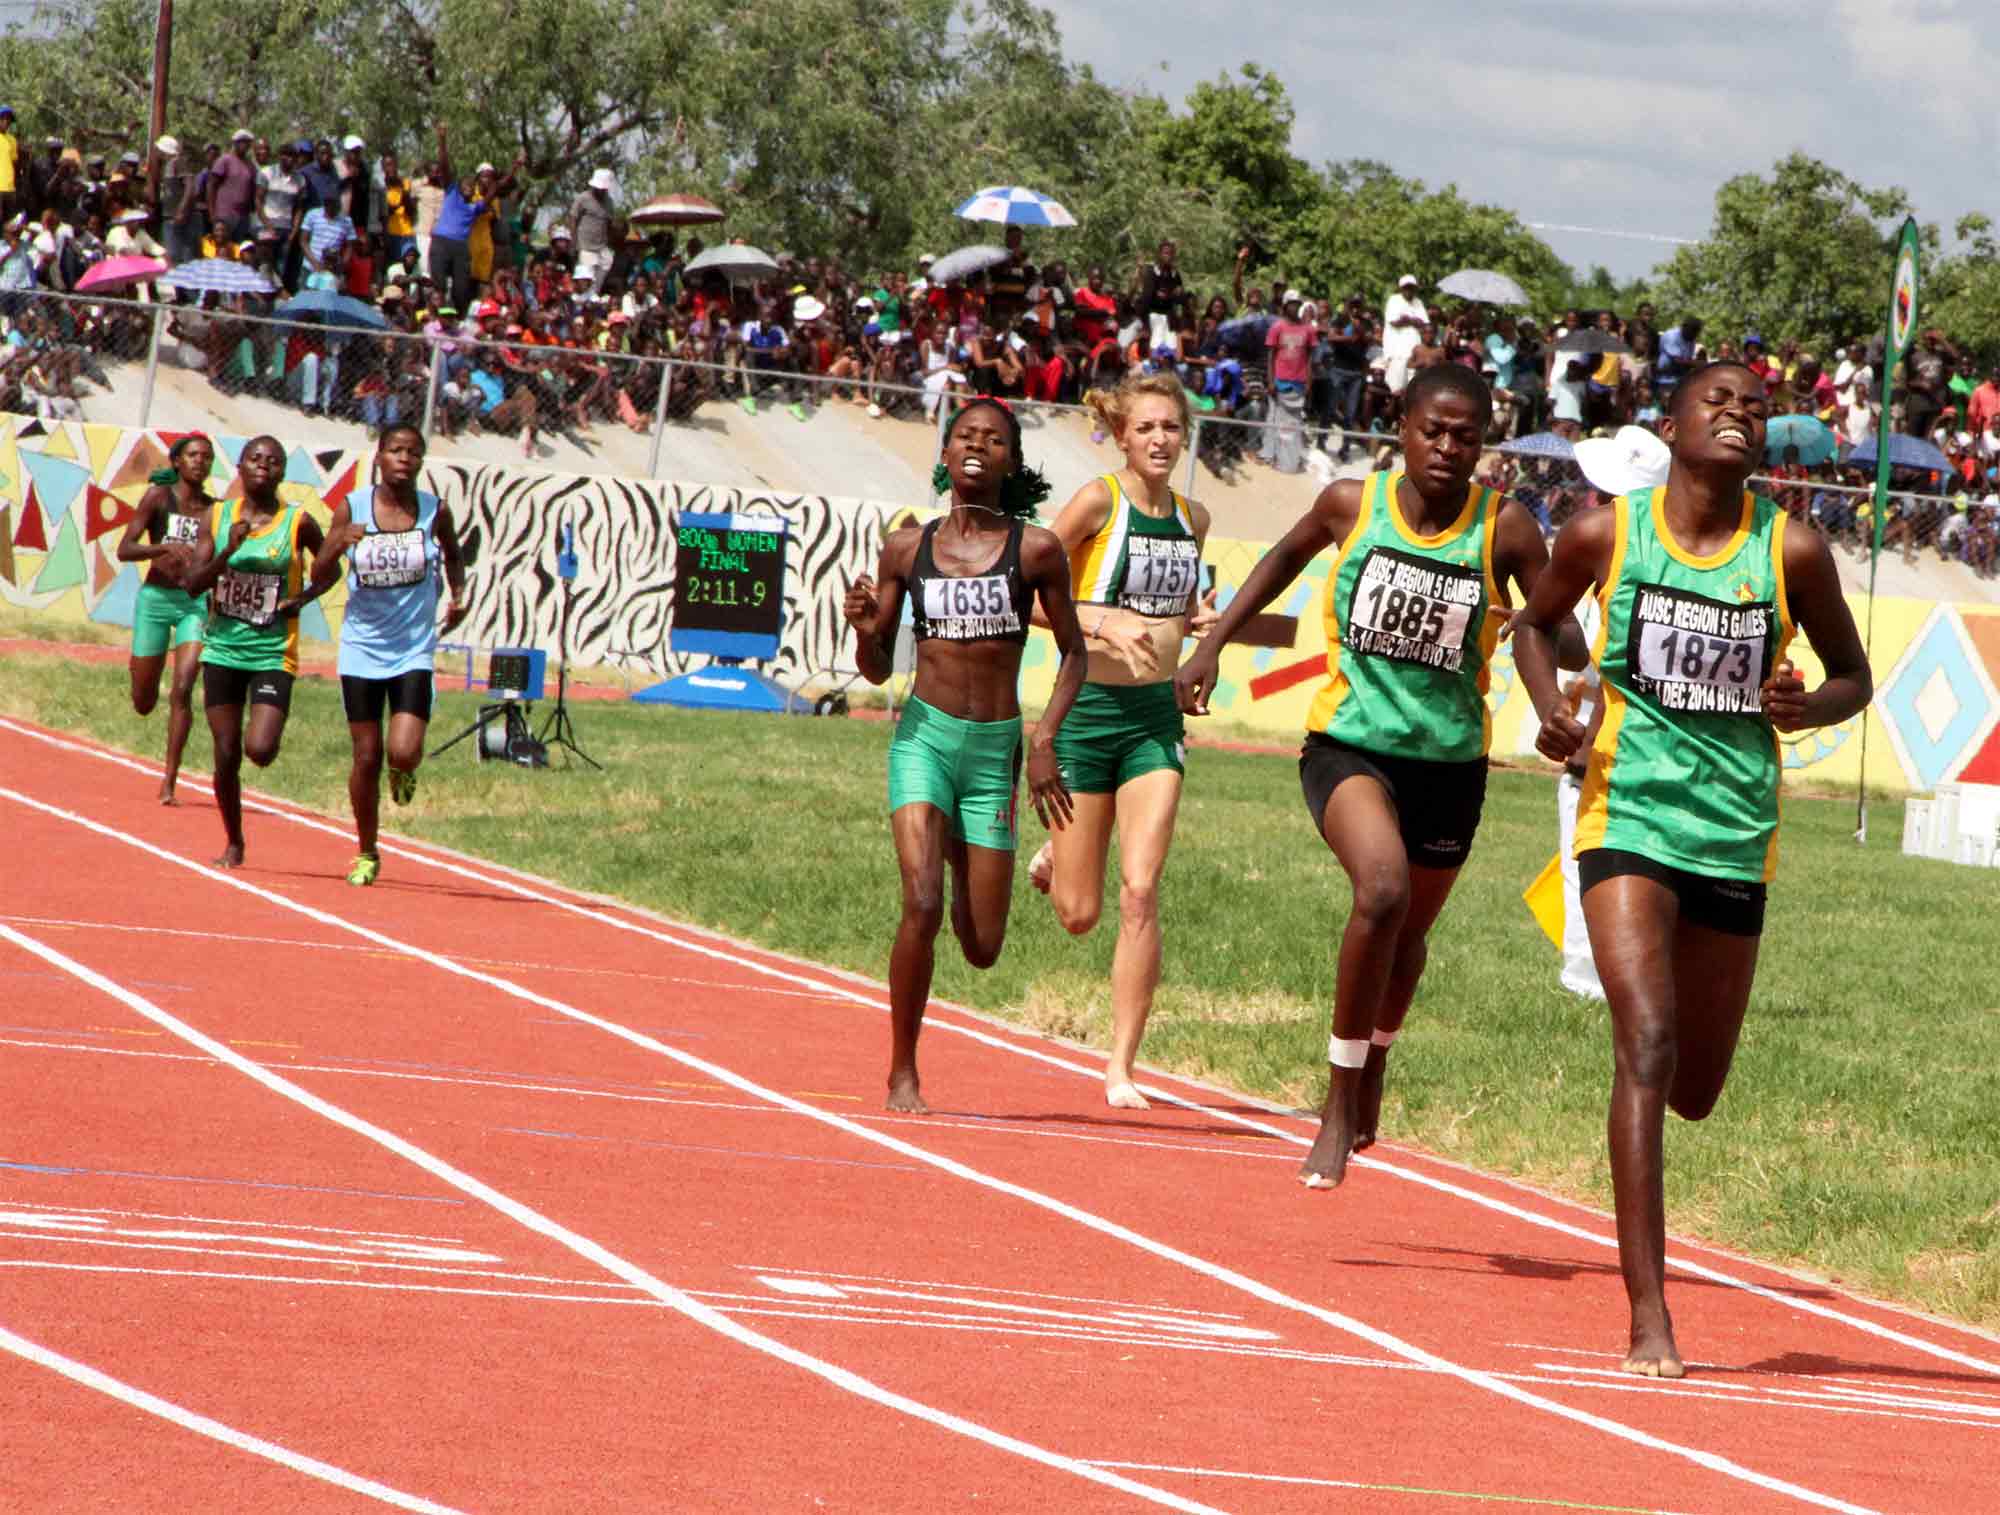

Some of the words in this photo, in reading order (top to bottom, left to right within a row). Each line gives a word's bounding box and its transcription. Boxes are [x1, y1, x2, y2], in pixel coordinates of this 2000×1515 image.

[727, 531, 778, 552] WOMEN
[366, 545, 409, 571] 1597
[699, 550, 750, 572] FINAL
[1144, 558, 1190, 593] 1757
[1392, 562, 1435, 596] REGION
[1434, 575, 1443, 598] 5
[1443, 576, 1481, 606] GAMES
[223, 581, 265, 611] 1845
[687, 576, 766, 607] 2:11.9
[938, 579, 1004, 616] 1635
[1369, 584, 1449, 643] 1885
[1638, 592, 1673, 624] AUSC
[1673, 601, 1720, 635] REGION
[1720, 611, 1729, 637] 5
[1394, 638, 1421, 659] 2014
[1661, 630, 1753, 684] 1873
[1662, 681, 1685, 709] DEC
[1687, 683, 1715, 710] 2014
